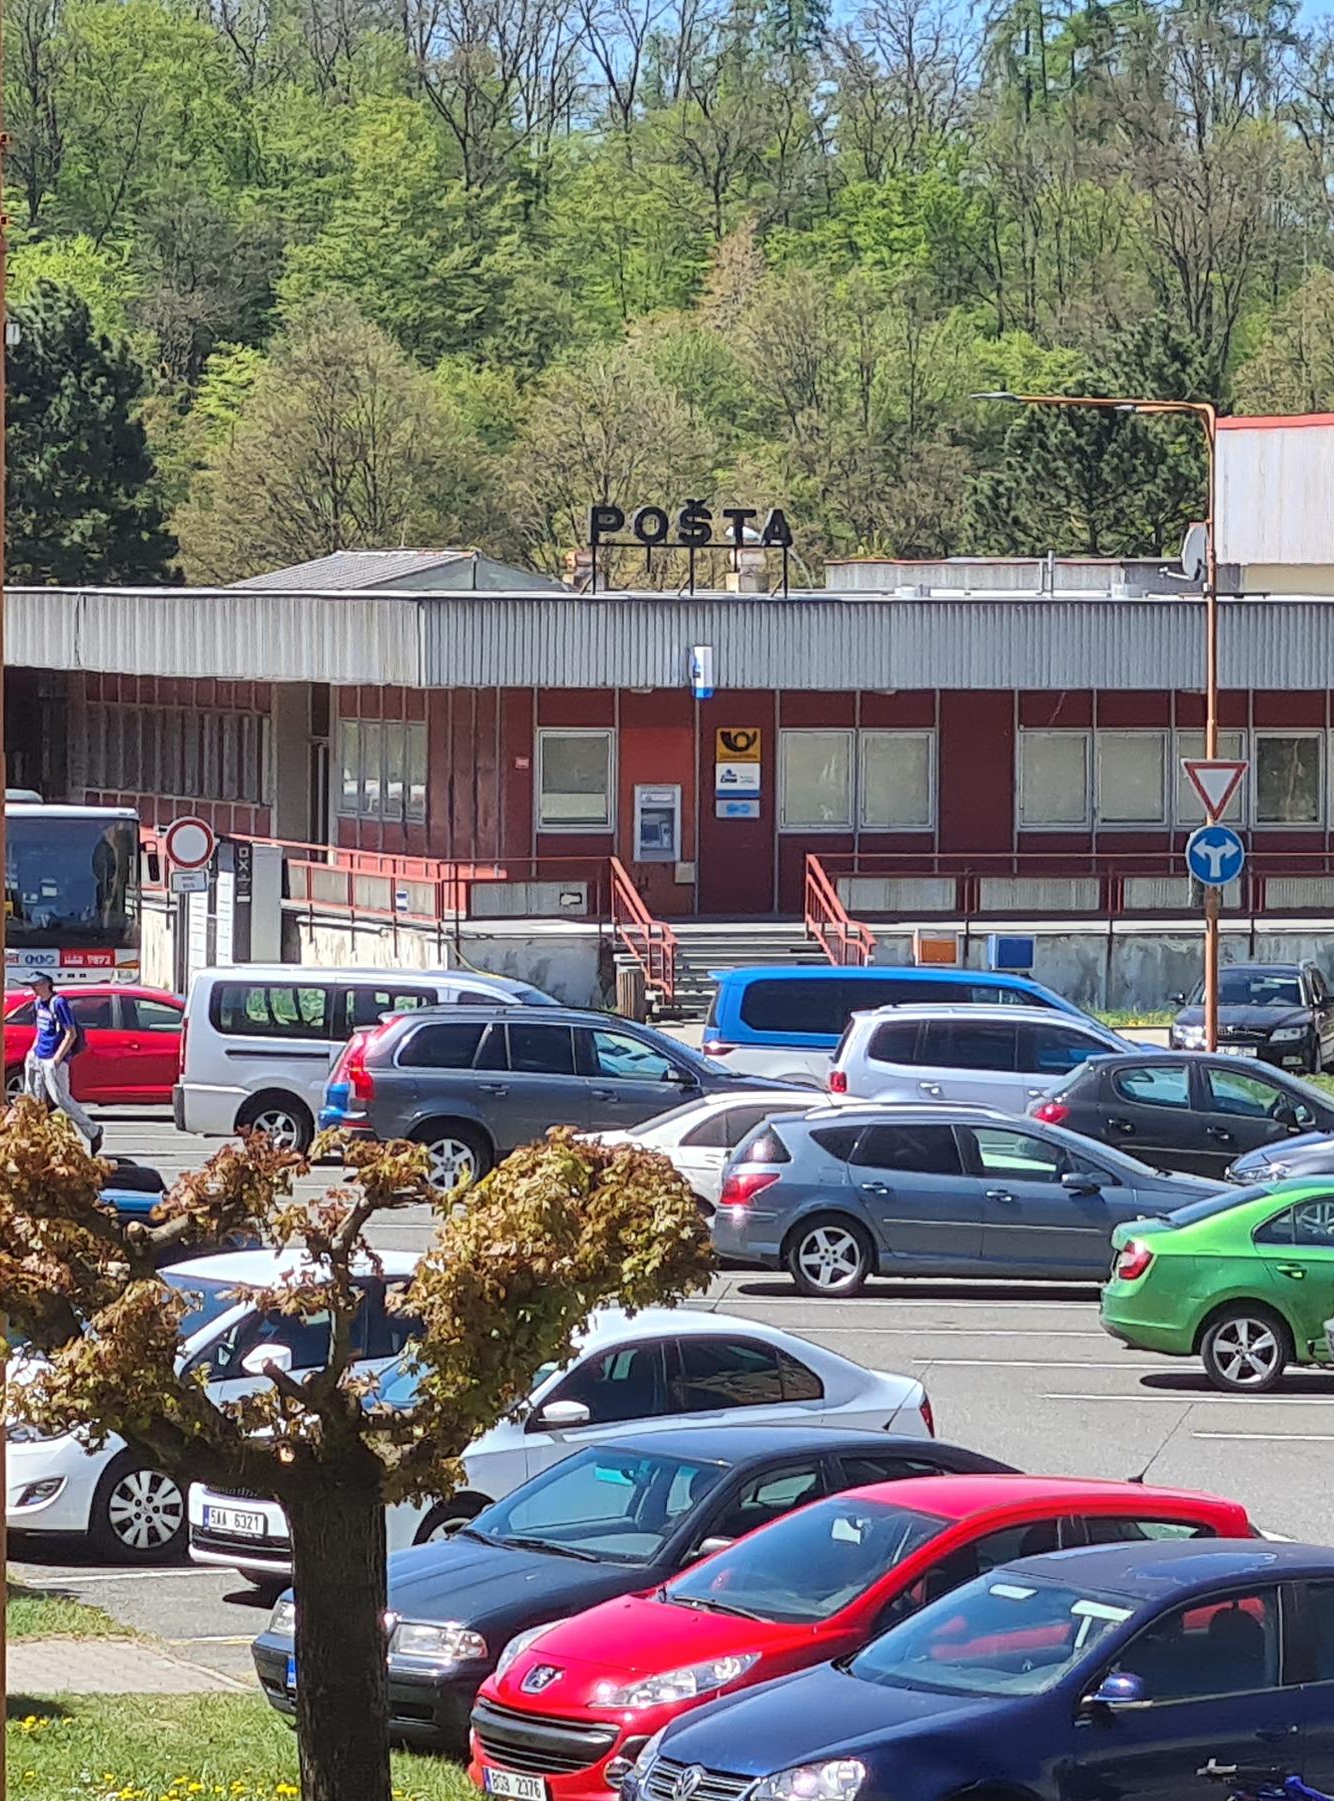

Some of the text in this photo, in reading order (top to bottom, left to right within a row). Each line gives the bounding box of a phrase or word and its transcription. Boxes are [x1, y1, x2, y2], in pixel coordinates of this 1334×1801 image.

[589, 499, 793, 547] POŠTA
[211, 1509, 259, 1531] 5AA 6321
